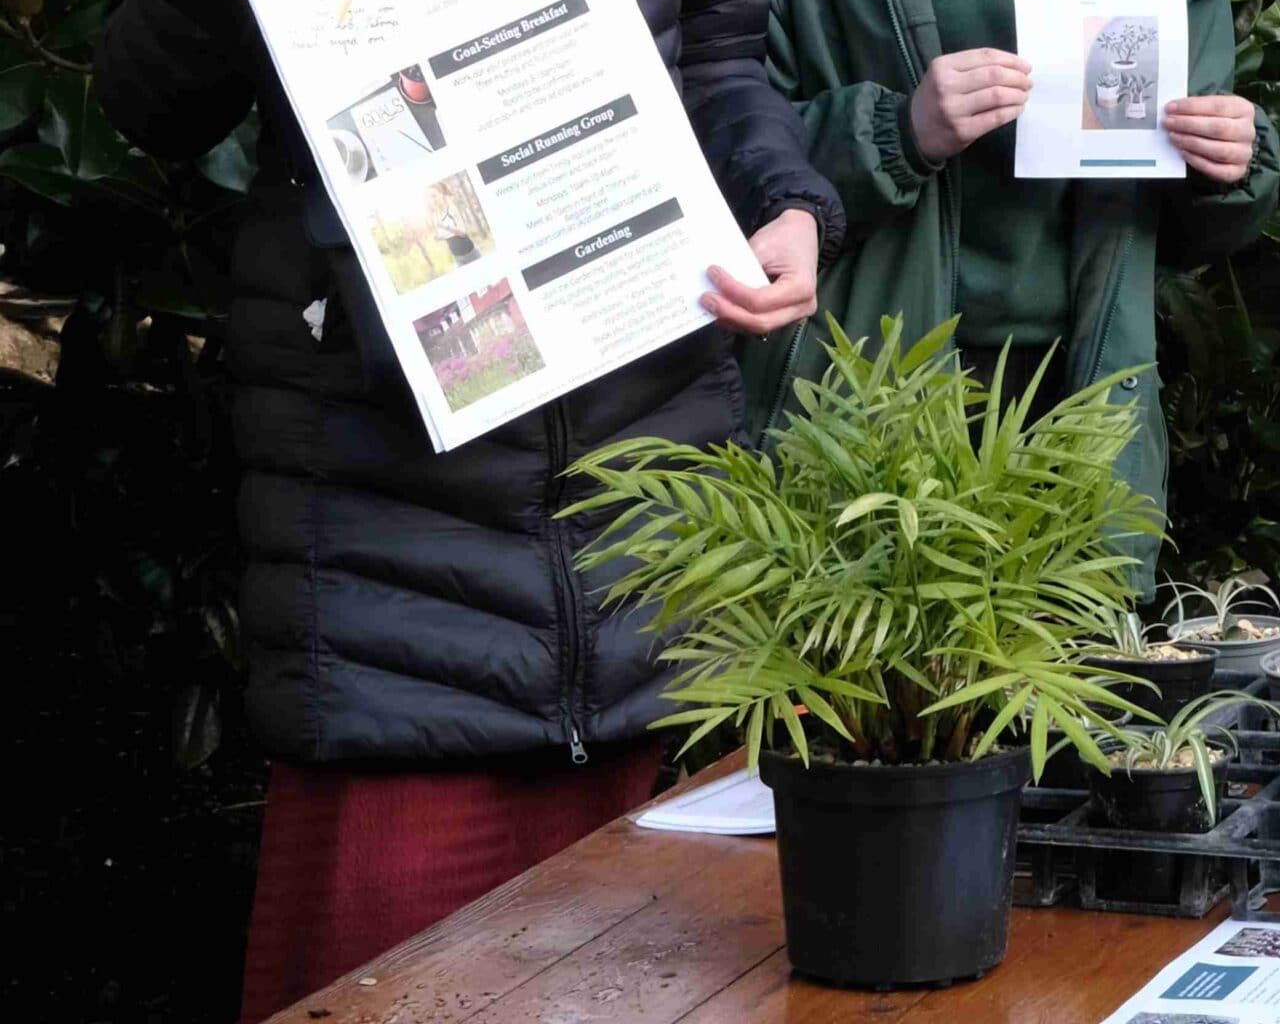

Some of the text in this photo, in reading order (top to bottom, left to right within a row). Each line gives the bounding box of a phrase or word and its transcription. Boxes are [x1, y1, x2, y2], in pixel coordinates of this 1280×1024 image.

[452, 25, 522, 63] Goal-Setting
[521, 4, 568, 32] Breakfast
[501, 108, 616, 167] Social Running Group
[574, 224, 633, 258] Gardening
